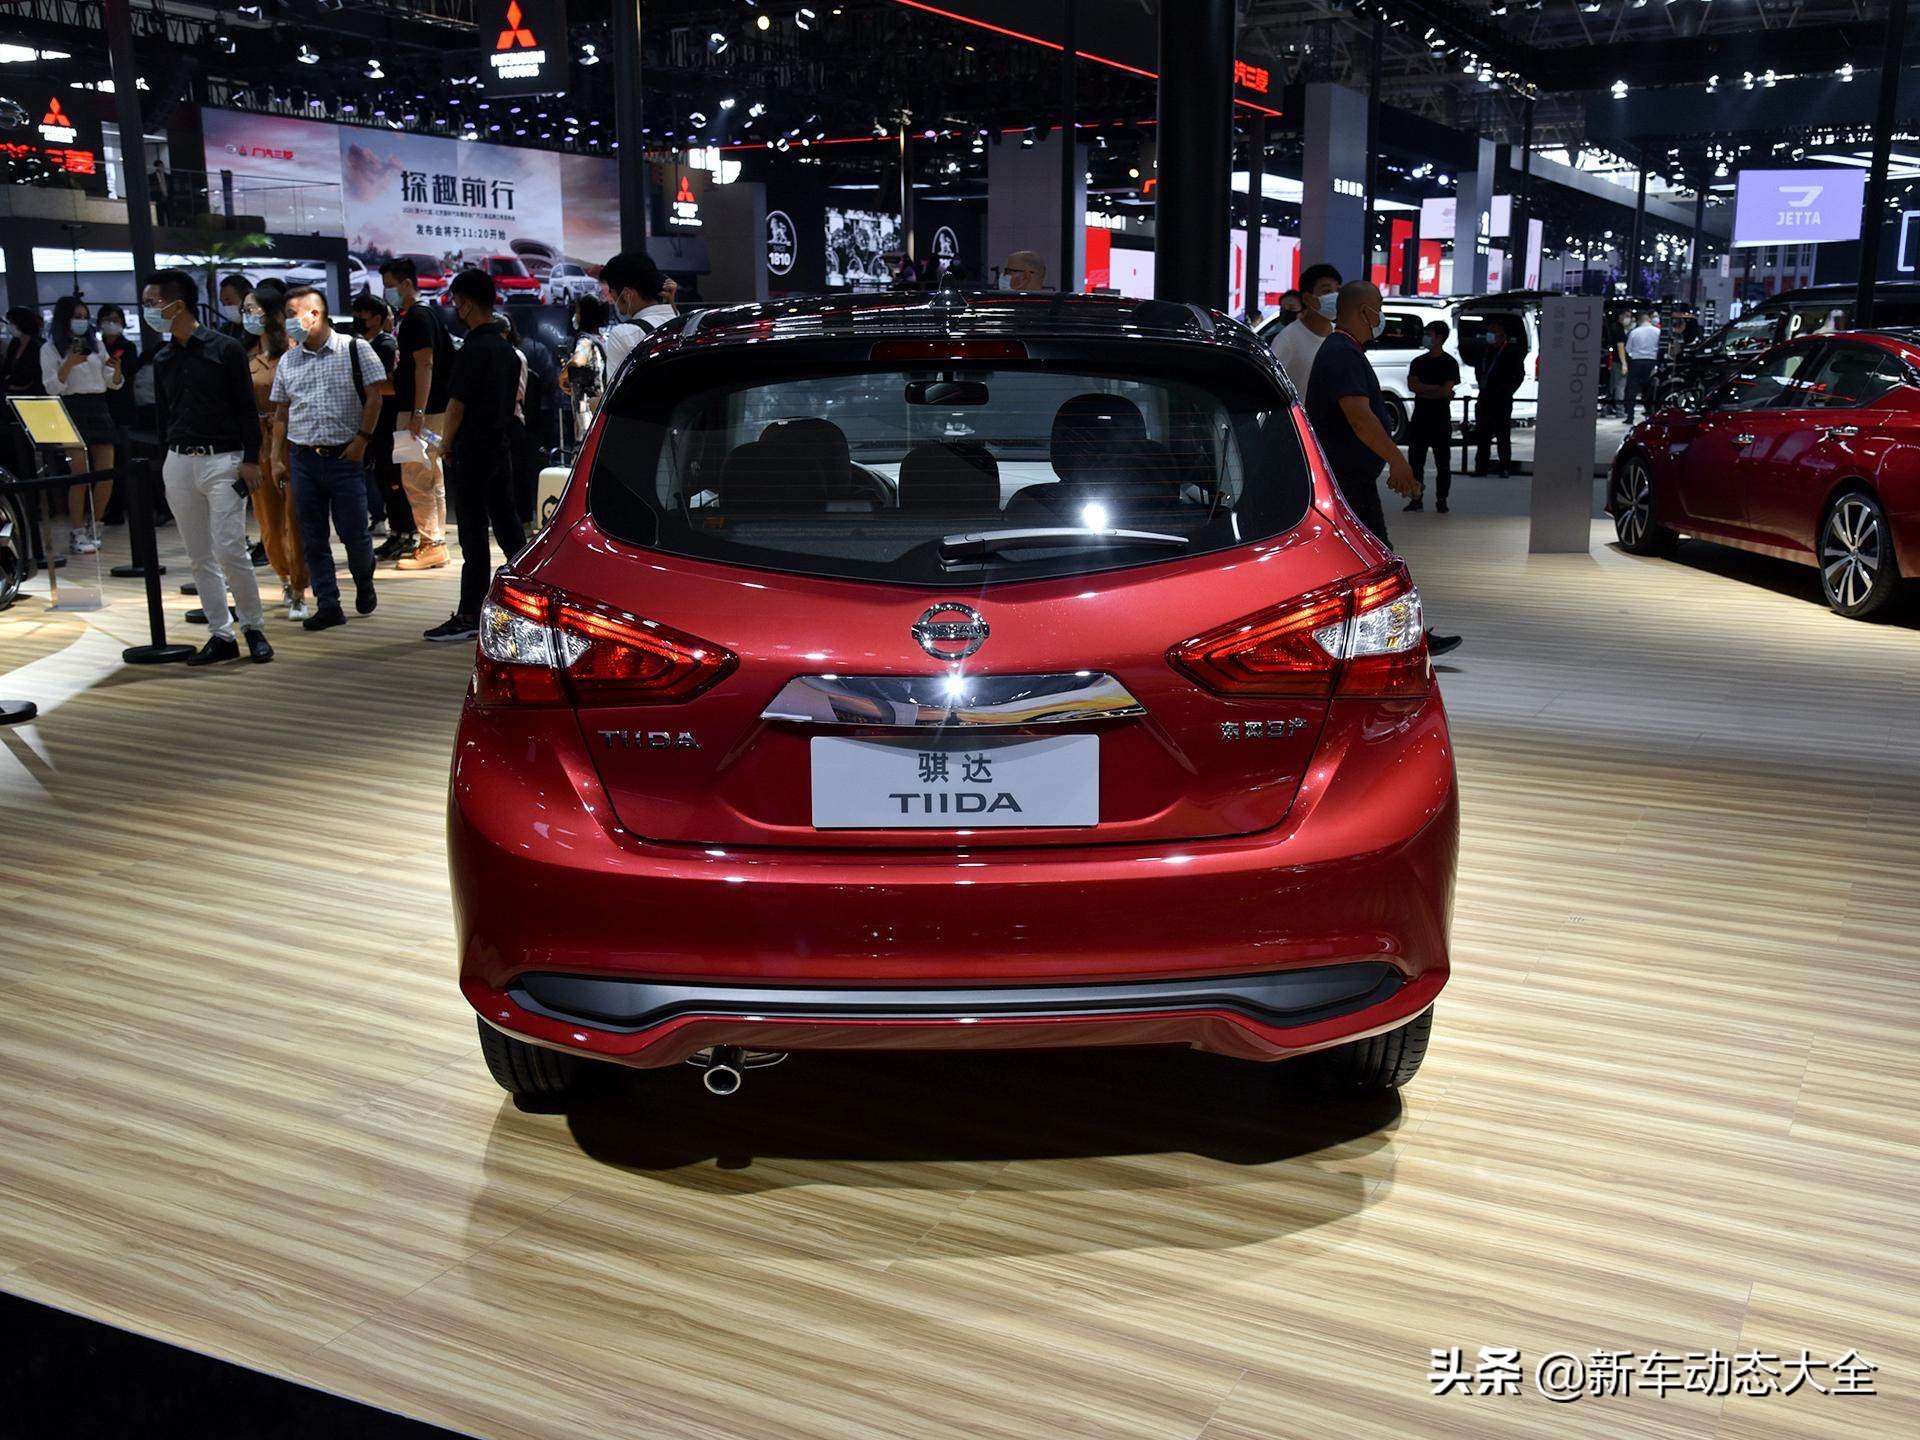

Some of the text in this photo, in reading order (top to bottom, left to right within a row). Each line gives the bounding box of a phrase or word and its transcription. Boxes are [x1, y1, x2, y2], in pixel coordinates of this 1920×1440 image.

[400, 170, 515, 210] 探趣前行
[1776, 211, 1822, 226] JETTA
[768, 252, 791, 266] 1810
[597, 730, 701, 749] TIIDA
[918, 752, 993, 783] 骐达
[888, 792, 1023, 814] TIIDA
